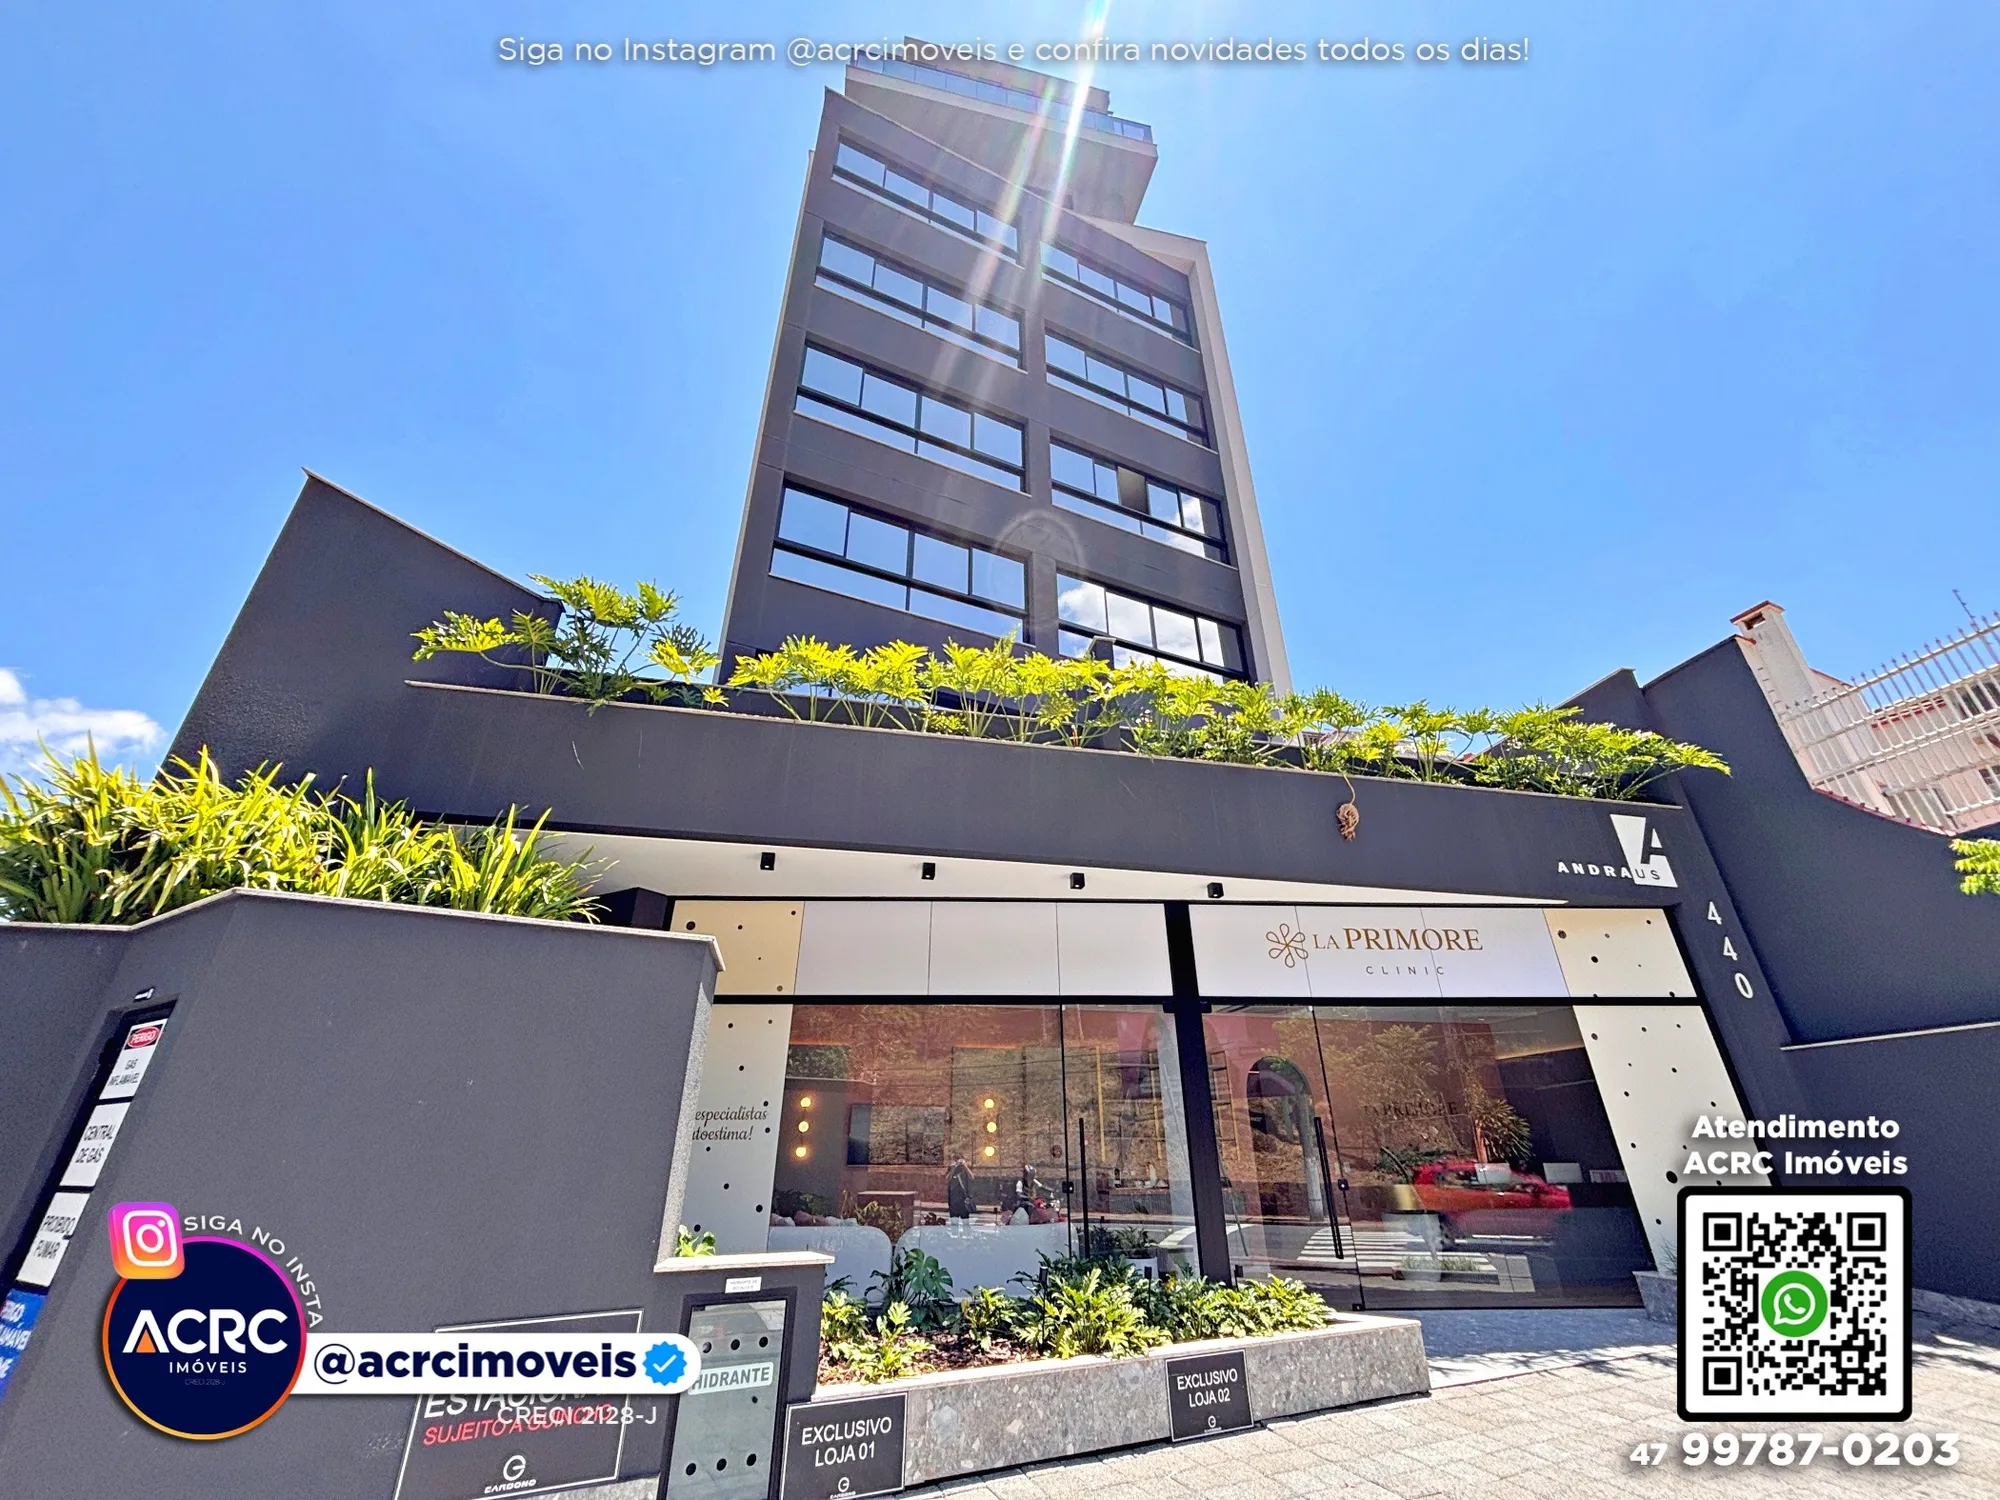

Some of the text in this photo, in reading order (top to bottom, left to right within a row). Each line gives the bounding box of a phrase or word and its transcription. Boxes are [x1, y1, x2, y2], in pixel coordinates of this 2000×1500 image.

[1557, 862, 1661, 880] ANDRAUS
[1312, 928, 1484, 951] LA PRIMORE
[1366, 966, 1445, 975] CLINIC
[694, 1106, 768, 1128] especialistas
[692, 1366, 771, 1390] HIDRANTE
[1177, 1368, 1238, 1391] EXCLUSIVO
[1188, 1387, 1231, 1408] LOJA 02
[423, 1418, 506, 1446] SUJEITO
[801, 1416, 892, 1445] EXCLUSIVO
[815, 1441, 875, 1467] LOJA 01
